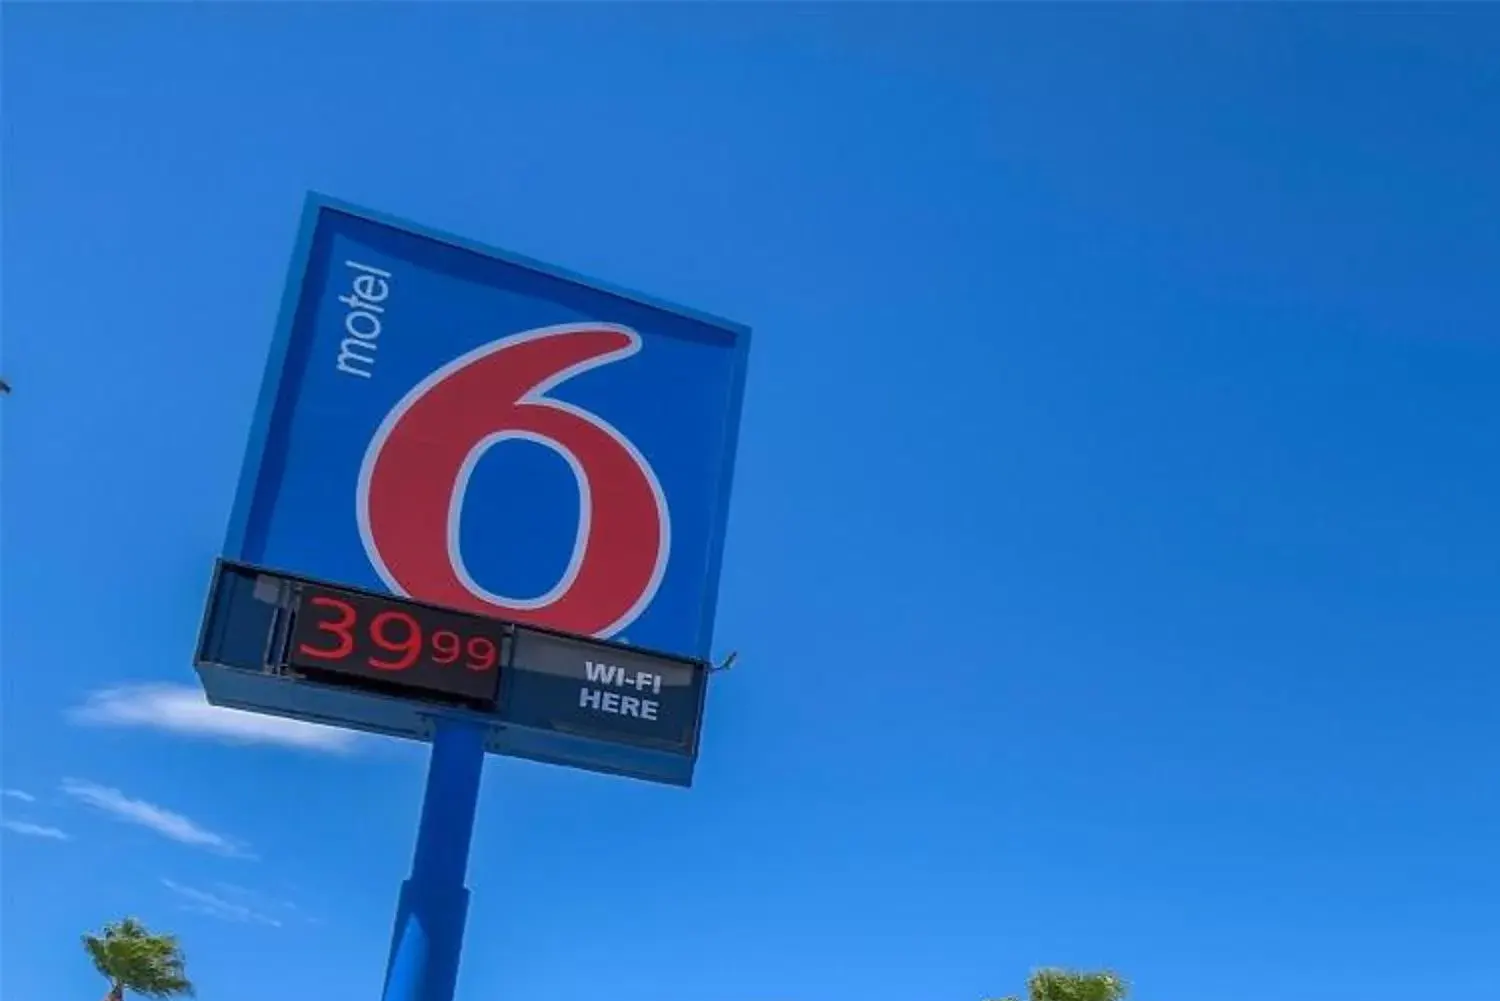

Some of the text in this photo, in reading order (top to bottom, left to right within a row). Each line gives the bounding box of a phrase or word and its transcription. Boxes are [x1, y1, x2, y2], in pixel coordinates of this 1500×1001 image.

[336, 260, 392, 379] motel
[356, 321, 671, 640] 6
[578, 687, 660, 722] HERE
[583, 659, 661, 695] WI-FI
